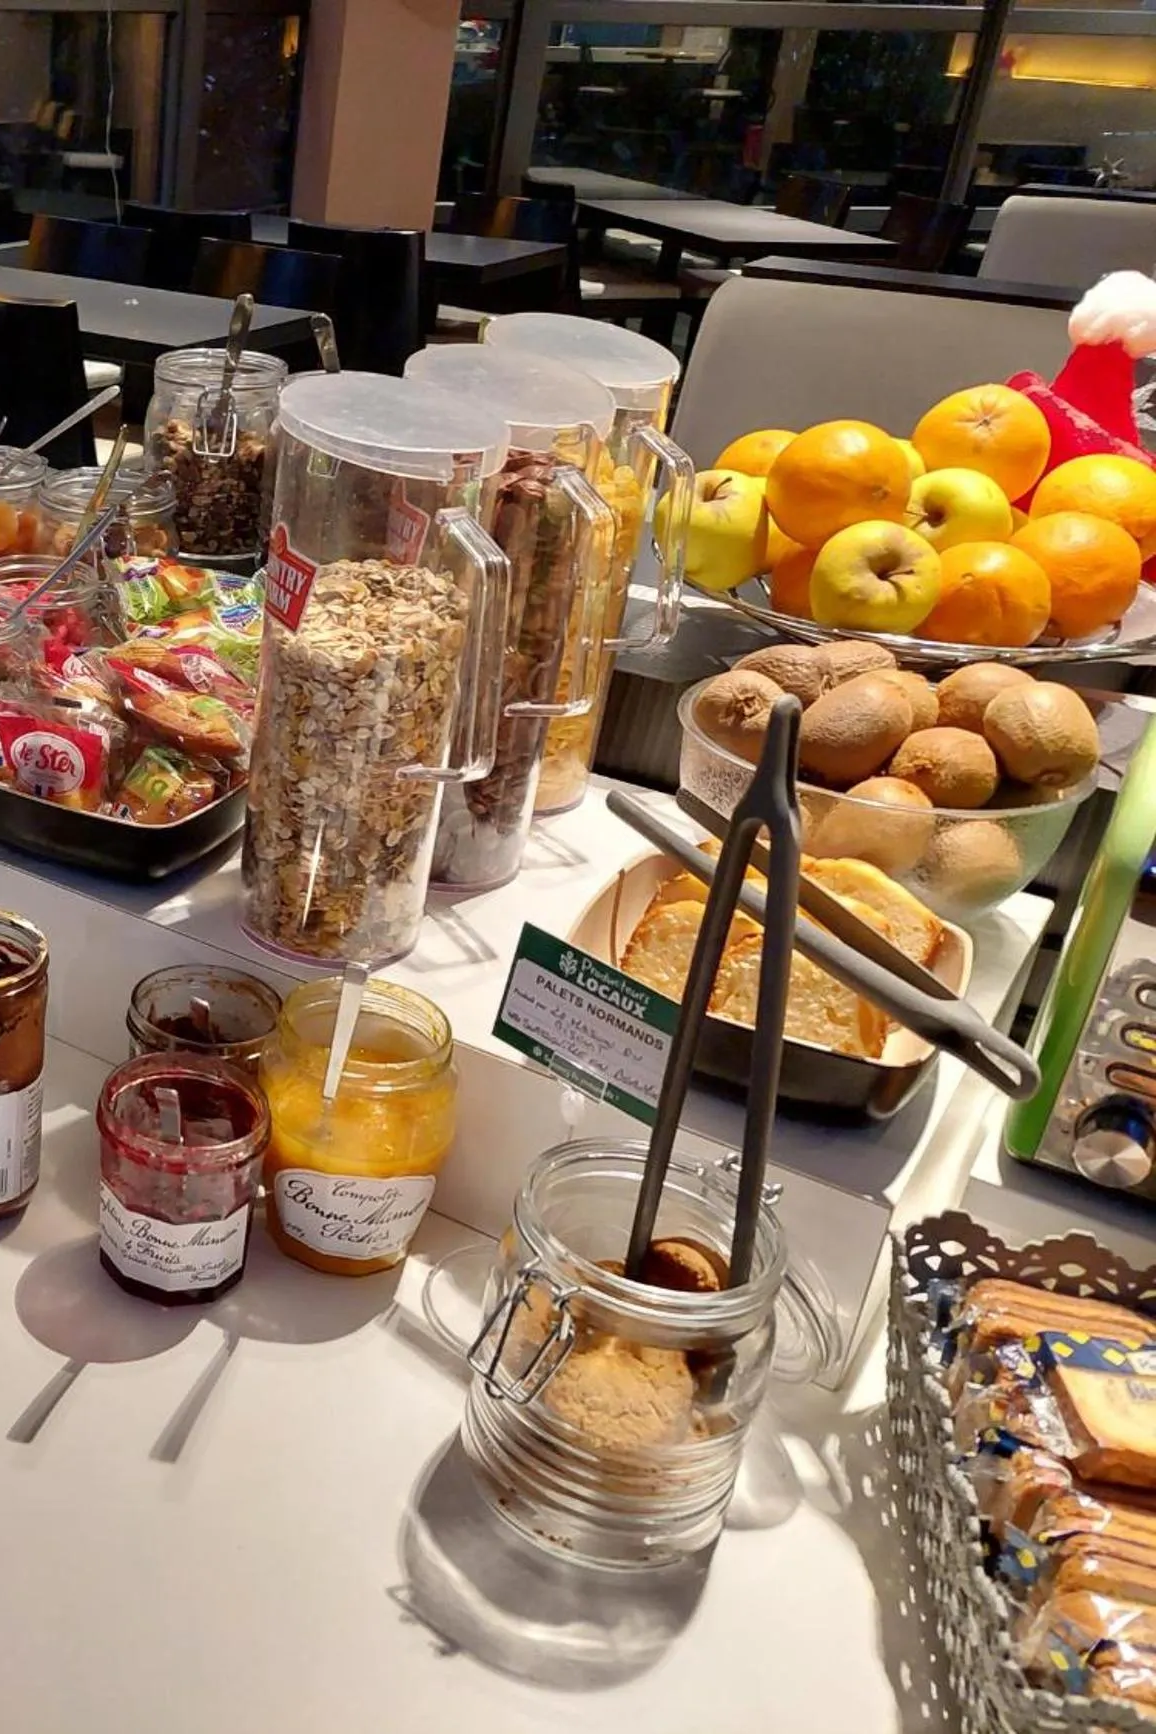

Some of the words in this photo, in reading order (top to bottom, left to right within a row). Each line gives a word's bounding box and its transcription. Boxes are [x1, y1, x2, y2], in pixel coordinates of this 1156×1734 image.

[19, 742, 33, 764] le
[35, 743, 77, 778] Ster
[576, 972, 648, 1019] LOCAUX
[581, 957, 650, 1005] Producteurs
[535, 974, 584, 1008] PALETS
[586, 1003, 665, 1051] NORMANDS
[284, 1180, 350, 1222] Bonne
[353, 1198, 426, 1226] Maman
[129, 1219, 178, 1248] Bonne
[181, 1225, 239, 1248] Maman
